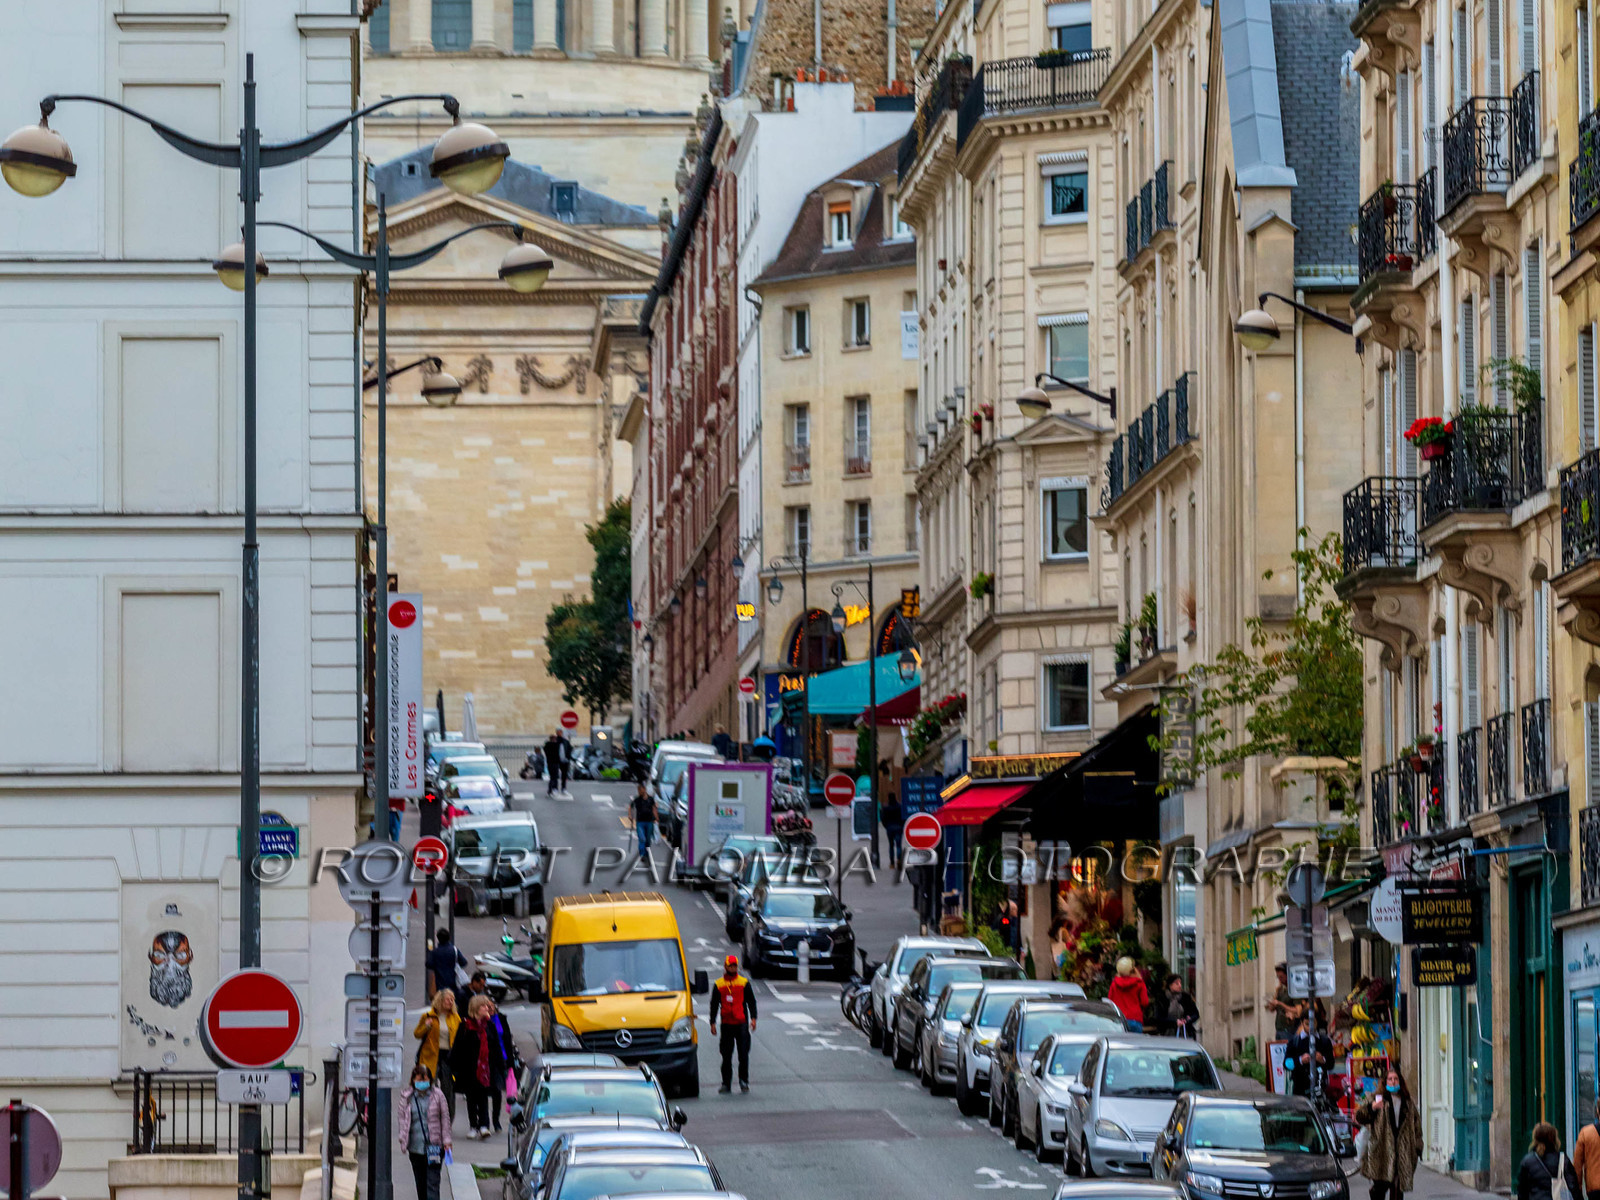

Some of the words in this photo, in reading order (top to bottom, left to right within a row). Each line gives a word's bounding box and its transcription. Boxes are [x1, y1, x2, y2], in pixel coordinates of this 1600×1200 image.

[389, 634, 400, 724] internationale
[405, 702, 417, 761] Carmes
[390, 725, 400, 790] Résidence
[405, 763, 417, 790] Les
[1411, 899, 1472, 916] BIJOUTERIE
[1413, 917, 1472, 930] JEWELLERY
[1420, 960, 1453, 971] SILVER
[1455, 963, 1471, 975] 925
[1419, 972, 1455, 983] ARGENT
[240, 1073, 269, 1084] SAUF
